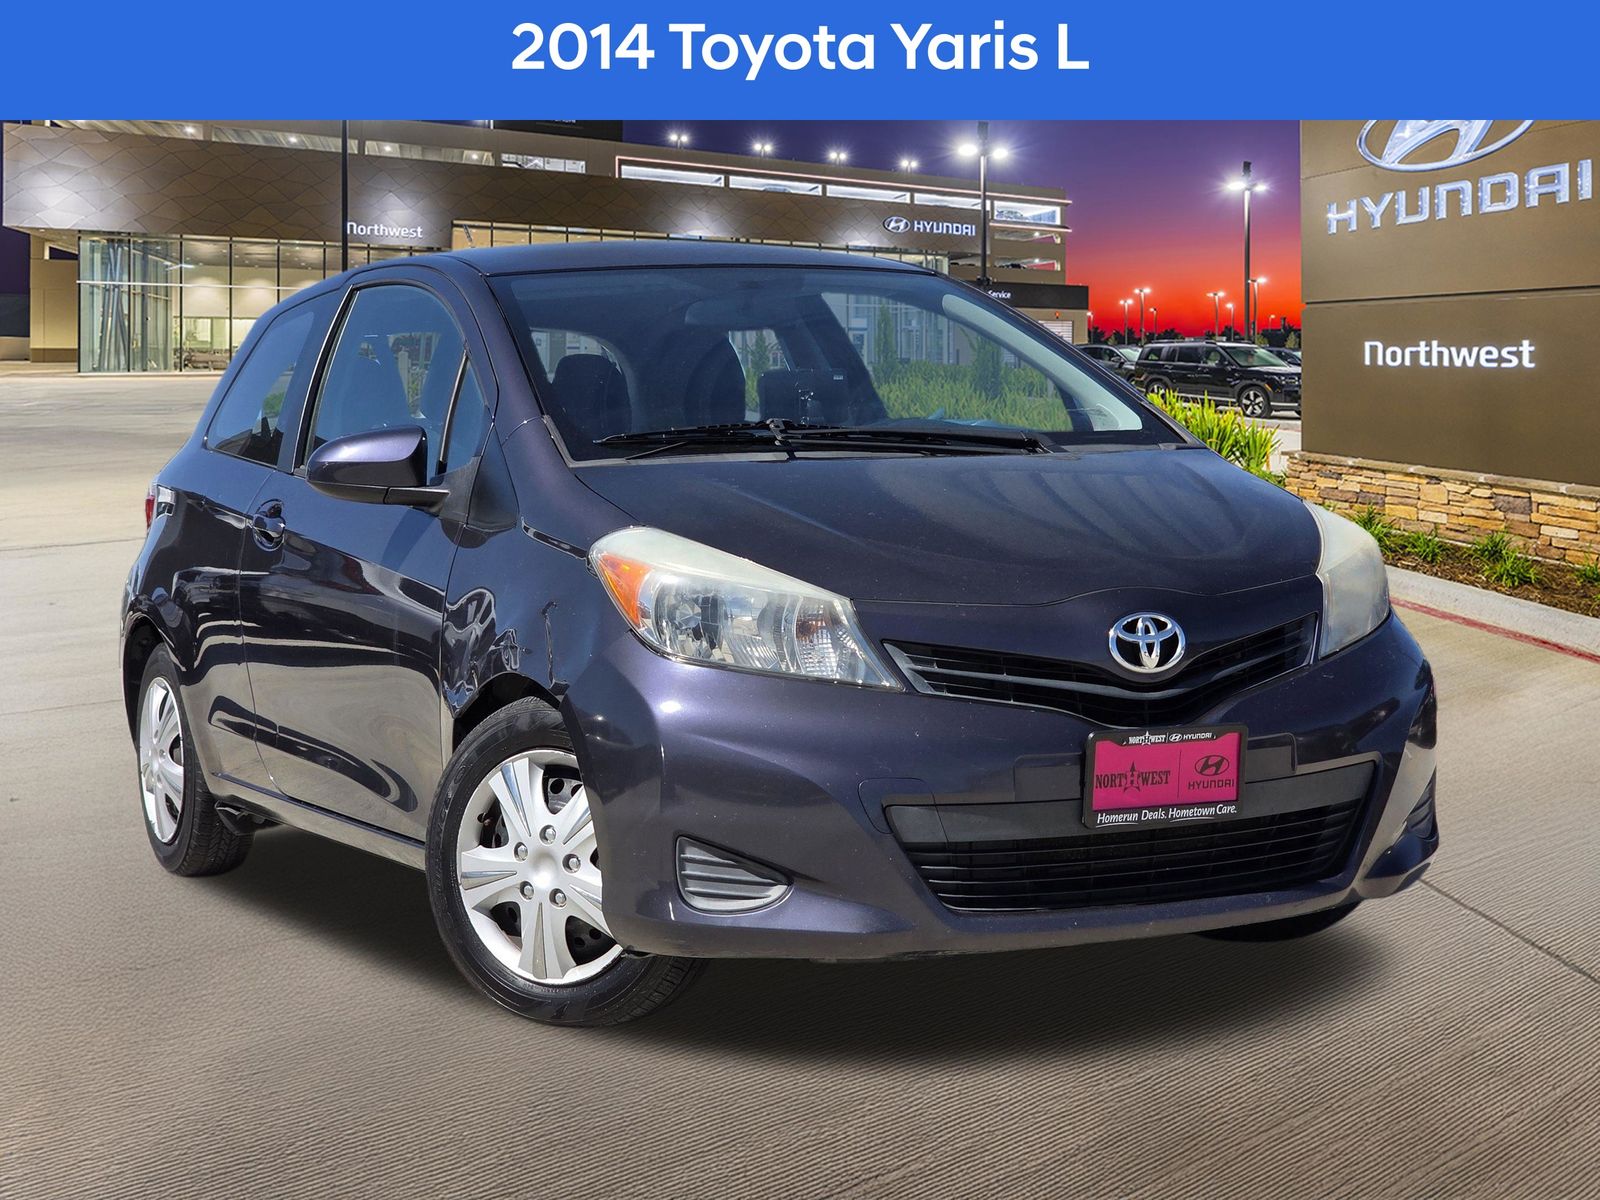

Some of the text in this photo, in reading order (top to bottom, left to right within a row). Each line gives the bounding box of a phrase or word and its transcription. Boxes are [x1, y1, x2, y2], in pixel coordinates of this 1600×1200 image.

[1326, 159, 1593, 235] HYUNDAI
[347, 221, 423, 238] Northwest
[914, 220, 976, 236] HYUNDAI
[1363, 339, 1536, 368] Northwest
[1183, 732, 1212, 740] HYUNDAI
[1187, 778, 1234, 790] HYUNDAI
[1097, 803, 1237, 824] Homerun Deals. Hometown Care.
